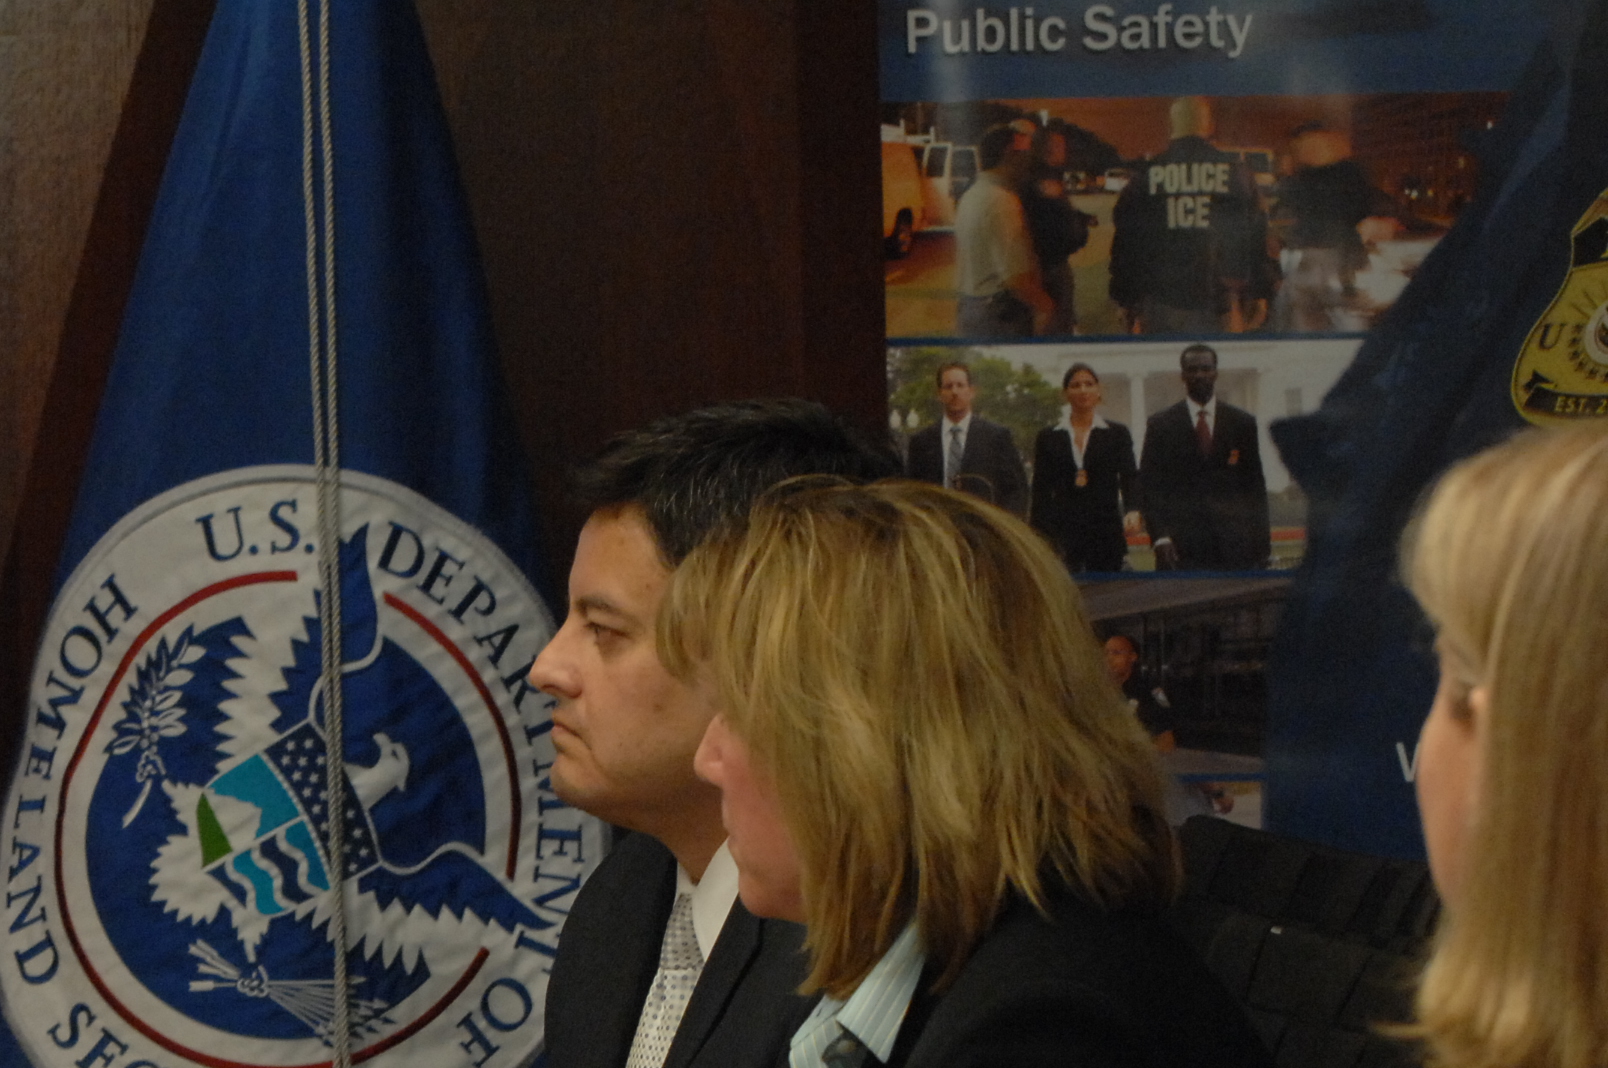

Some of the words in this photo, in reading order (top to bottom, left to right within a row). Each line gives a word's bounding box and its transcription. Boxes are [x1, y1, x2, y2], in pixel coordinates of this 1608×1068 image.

[906, 7, 1067, 54] Public
[1082, 4, 1253, 58] Safety
[1148, 163, 1230, 195] POLICE
[1167, 196, 1211, 229] ICE
[196, 499, 316, 563] U.S.
[5, 572, 139, 990] HOMELAND
